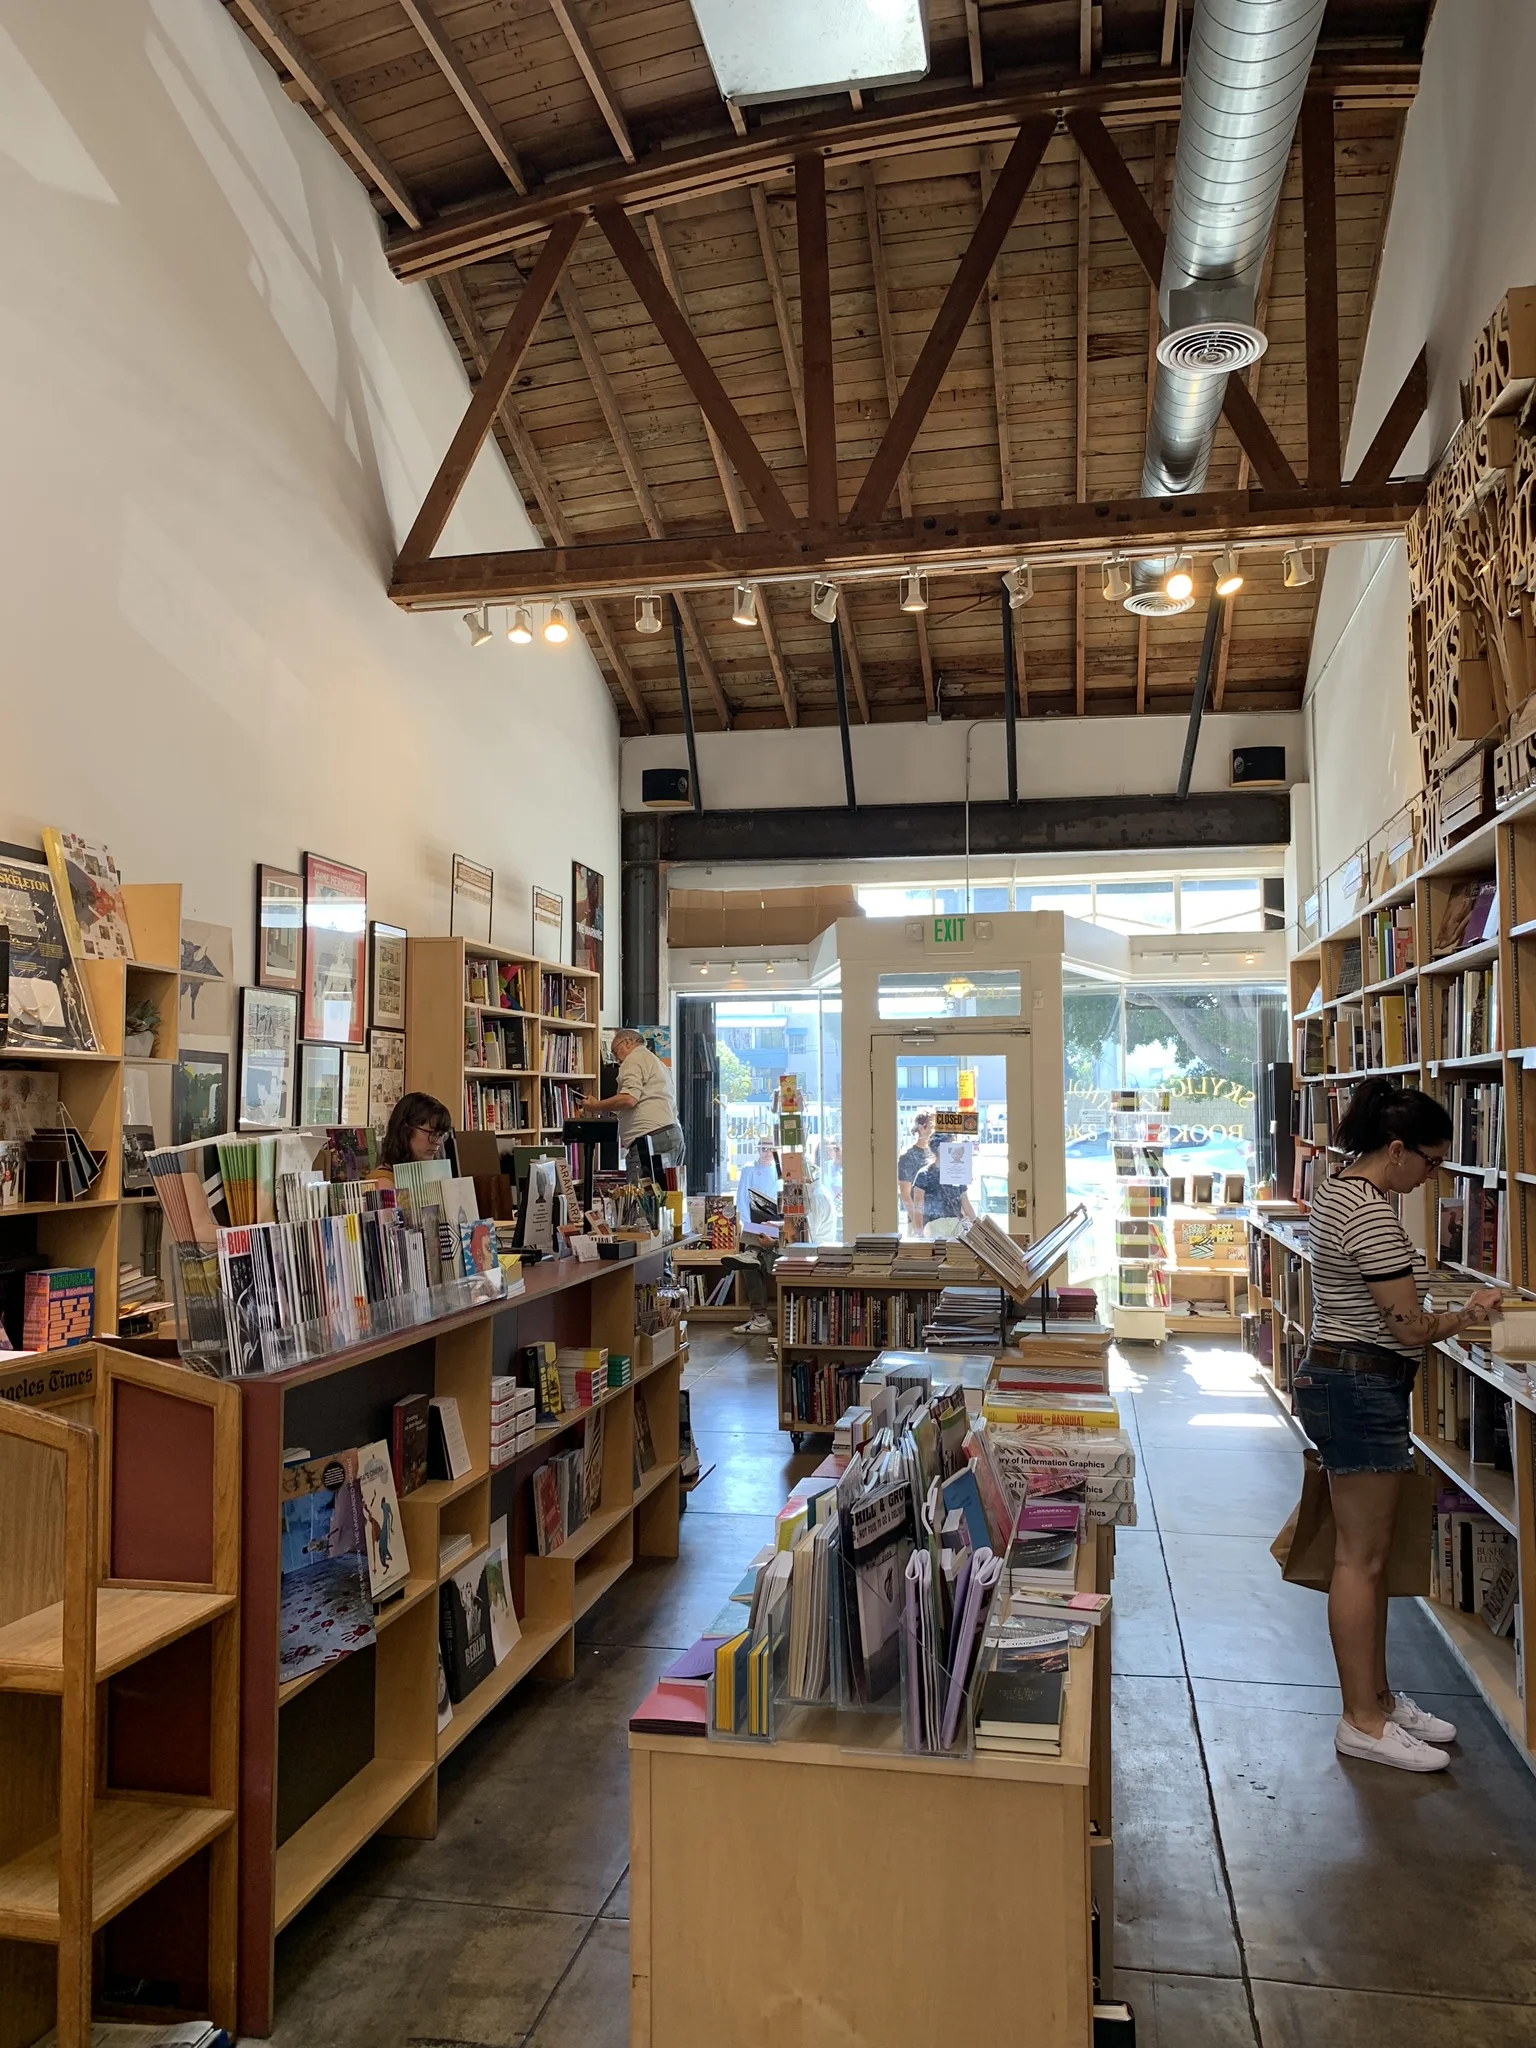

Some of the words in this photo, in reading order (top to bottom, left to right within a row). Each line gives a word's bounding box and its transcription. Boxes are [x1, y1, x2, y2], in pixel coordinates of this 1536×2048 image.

[0, 873, 49, 892] SKELETON
[934, 918, 965, 942] EXIT
[936, 1113, 963, 1125] CLOSED
[559, 1164, 573, 1197] ARAKI
[49, 1368, 93, 1393] Times
[1017, 1412, 1044, 1425] WARHOL
[1051, 1415, 1084, 1427] BASQUIAT
[1021, 1457, 1068, 1467] Information
[1069, 1460, 1105, 1469] Graphics
[1008, 1481, 1018, 1489] of
[1086, 1485, 1103, 1493] hics
[880, 1498, 885, 1513] &
[1088, 1507, 1106, 1517] hics
[465, 1633, 487, 1667] BERLIN
